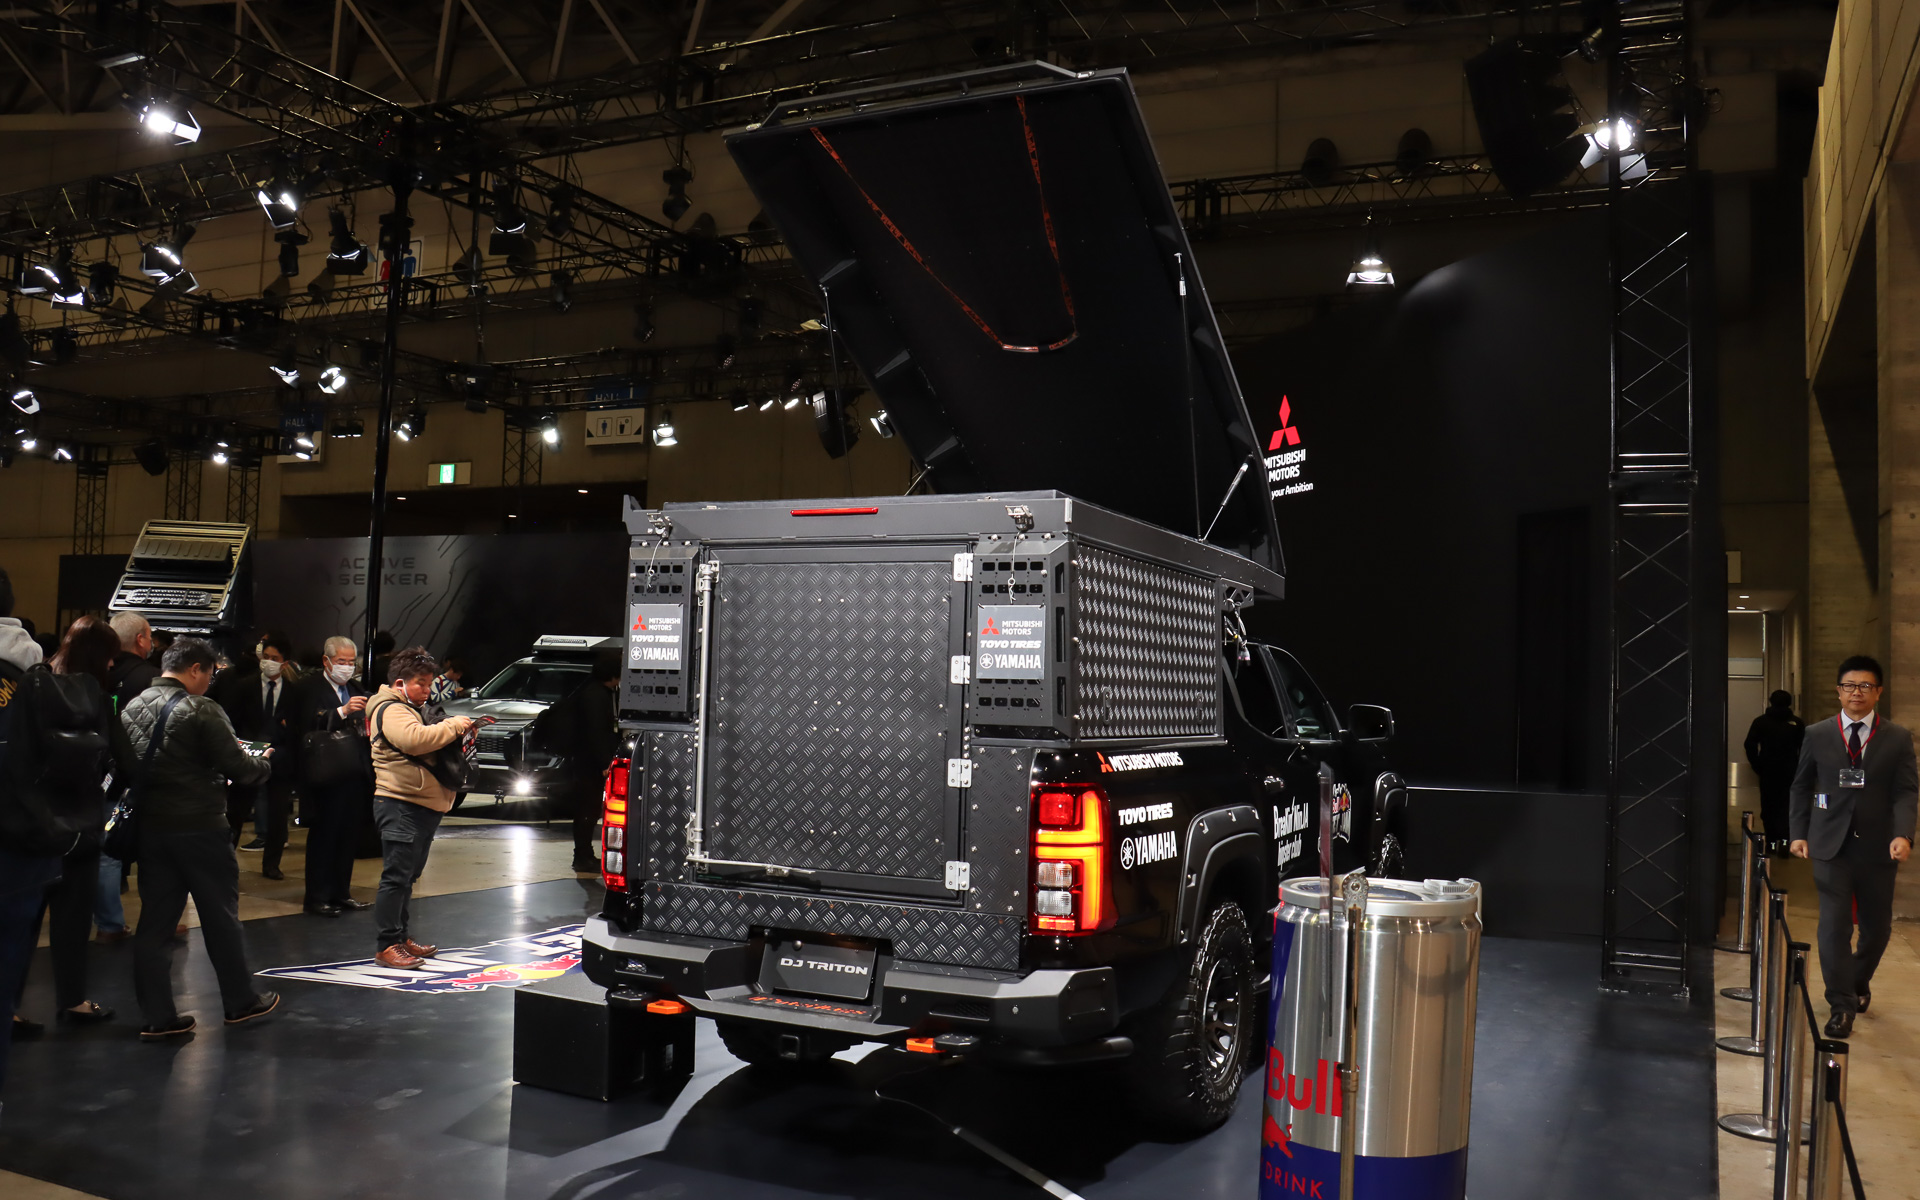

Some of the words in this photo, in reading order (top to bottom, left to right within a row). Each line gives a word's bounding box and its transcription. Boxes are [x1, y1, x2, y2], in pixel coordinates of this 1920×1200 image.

[1264, 448, 1306, 470] MITSUBISHI
[1268, 464, 1300, 483] MOTORS
[1271, 488, 1285, 500] your
[1285, 482, 1313, 496] Ambition
[339, 557, 415, 570] ACIVE
[339, 573, 428, 586] SEKER
[1001, 628, 1032, 636] MOTORS
[1002, 620, 1043, 628] MITSUBISHI
[631, 634, 655, 643] TOYO
[654, 635, 680, 643] TIRES
[980, 640, 1009, 649] TOYO
[1009, 640, 1042, 649] TIRES
[642, 647, 679, 661] YAMAHA
[994, 654, 1041, 669] YAMAHA
[1108, 753, 1156, 772] MITSUBISHI
[1151, 751, 1184, 768] MOTORS
[1118, 806, 1146, 826] TOYO
[1146, 802, 1173, 821] TIRES
[1135, 831, 1178, 866] YAMAHA
[780, 957, 804, 968] DJ
[807, 960, 868, 975] TRITON
[1267, 1046, 1343, 1118] Bull
[1265, 1161, 1324, 1200] DRINK
